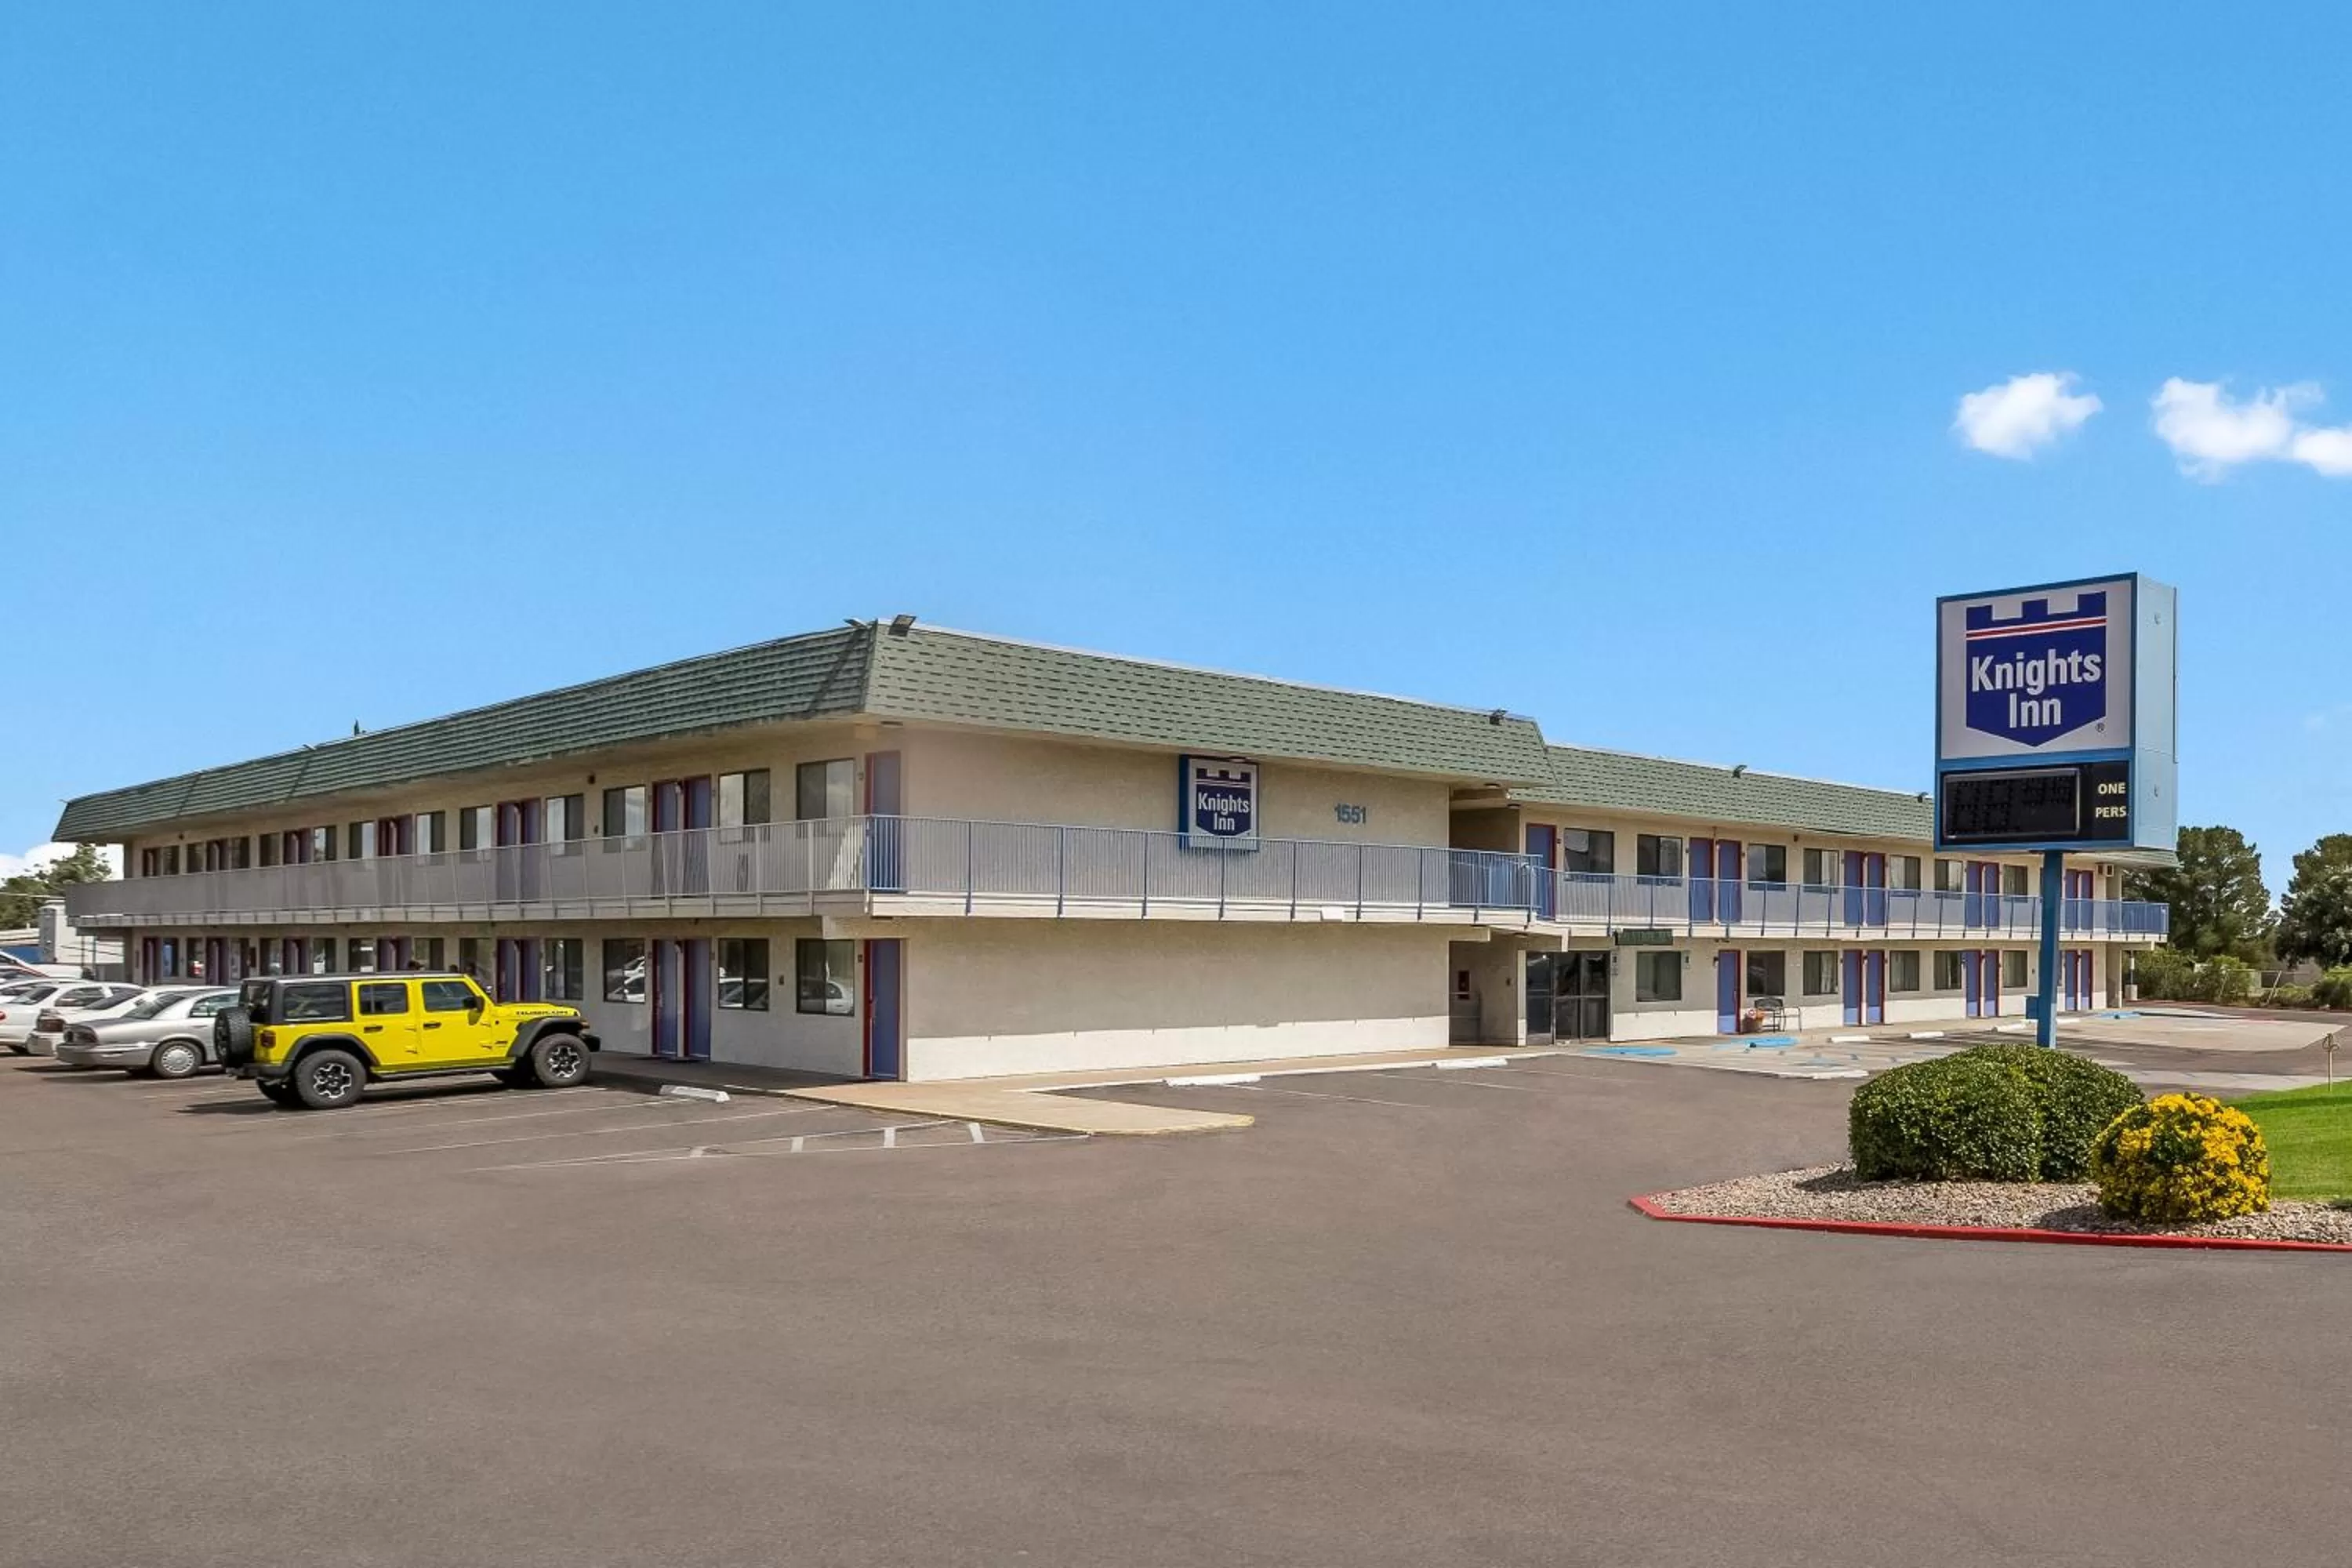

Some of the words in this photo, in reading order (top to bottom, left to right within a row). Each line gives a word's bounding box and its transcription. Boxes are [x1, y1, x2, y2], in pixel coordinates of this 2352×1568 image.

[1972, 648, 2102, 695] Knights
[2009, 692, 2062, 728] Inn
[2097, 782, 2126, 795] ONE
[1198, 792, 1250, 815] Knights
[1334, 803, 1367, 824] 1551
[2095, 806, 2127, 819] PERS
[1213, 813, 1235, 831] Inn
